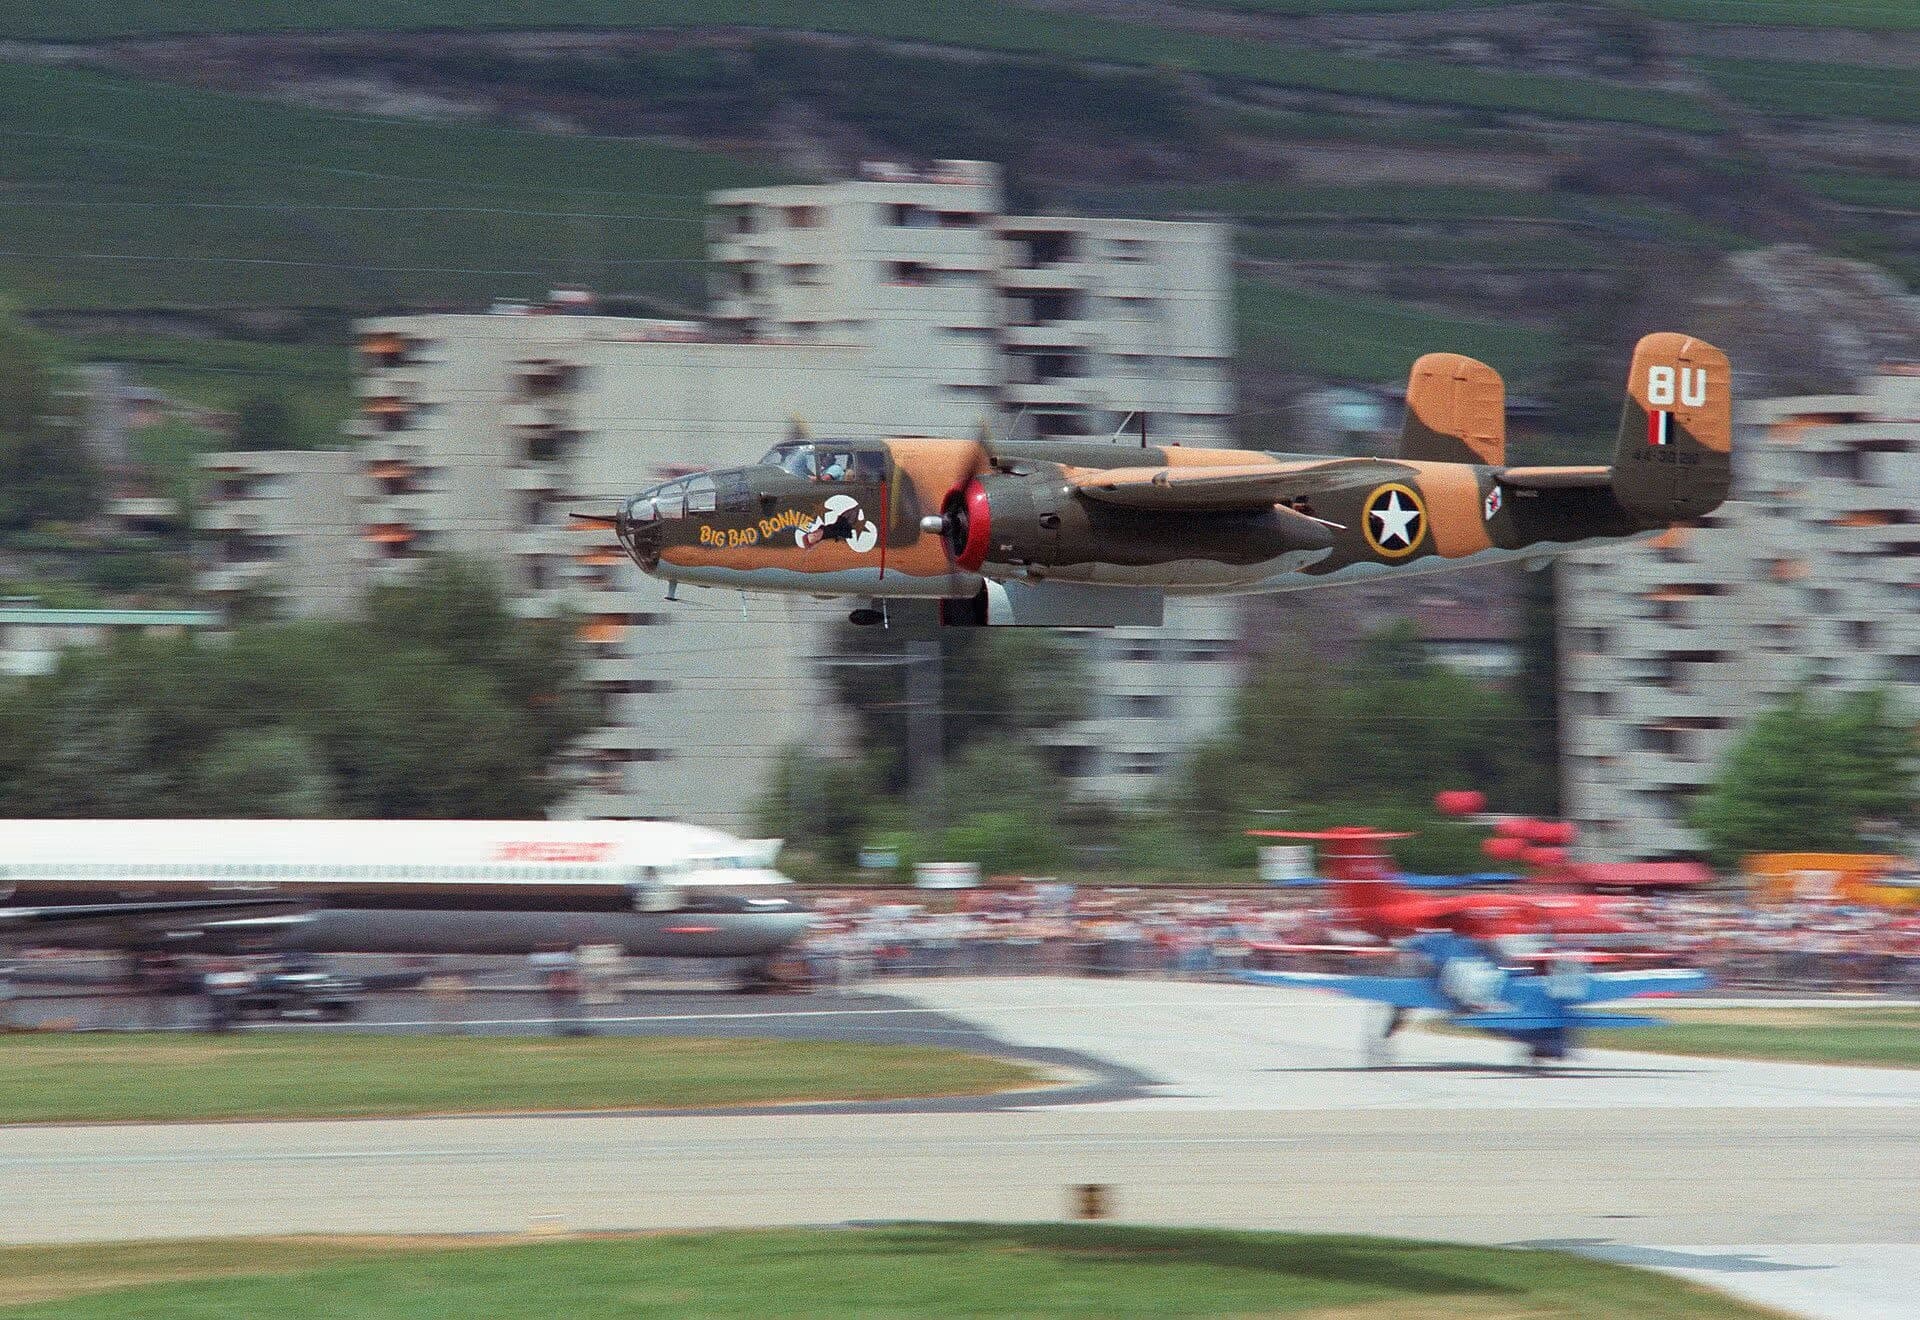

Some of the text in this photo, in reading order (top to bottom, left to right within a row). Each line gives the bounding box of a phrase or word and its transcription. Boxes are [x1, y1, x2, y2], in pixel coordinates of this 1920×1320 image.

[700, 509, 814, 547] BIG BAD BONNIE
